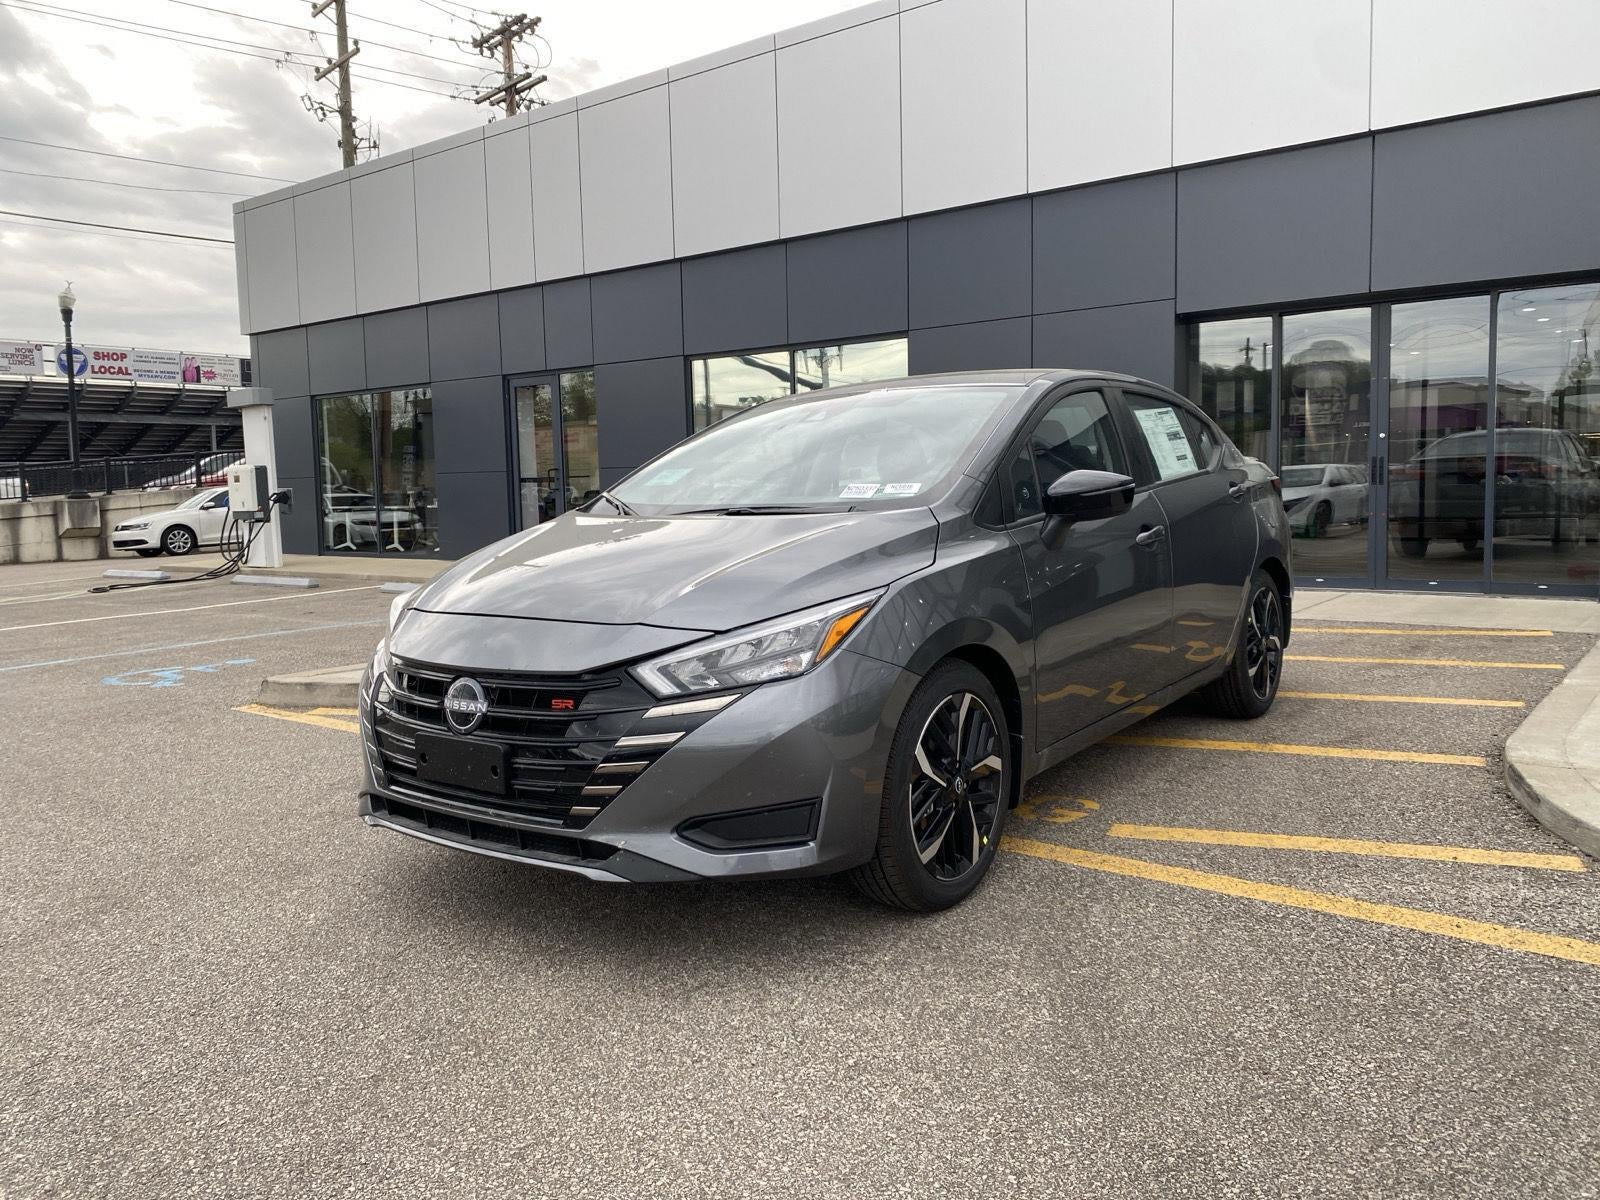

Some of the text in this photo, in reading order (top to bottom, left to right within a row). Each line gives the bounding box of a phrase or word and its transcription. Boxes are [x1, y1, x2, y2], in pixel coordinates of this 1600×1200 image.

[0, 352, 34, 360] SERVING
[93, 351, 128, 362] SHOP
[91, 364, 132, 376] LOCAL
[444, 698, 487, 712] NISSAN
[551, 699, 574, 710] SR
